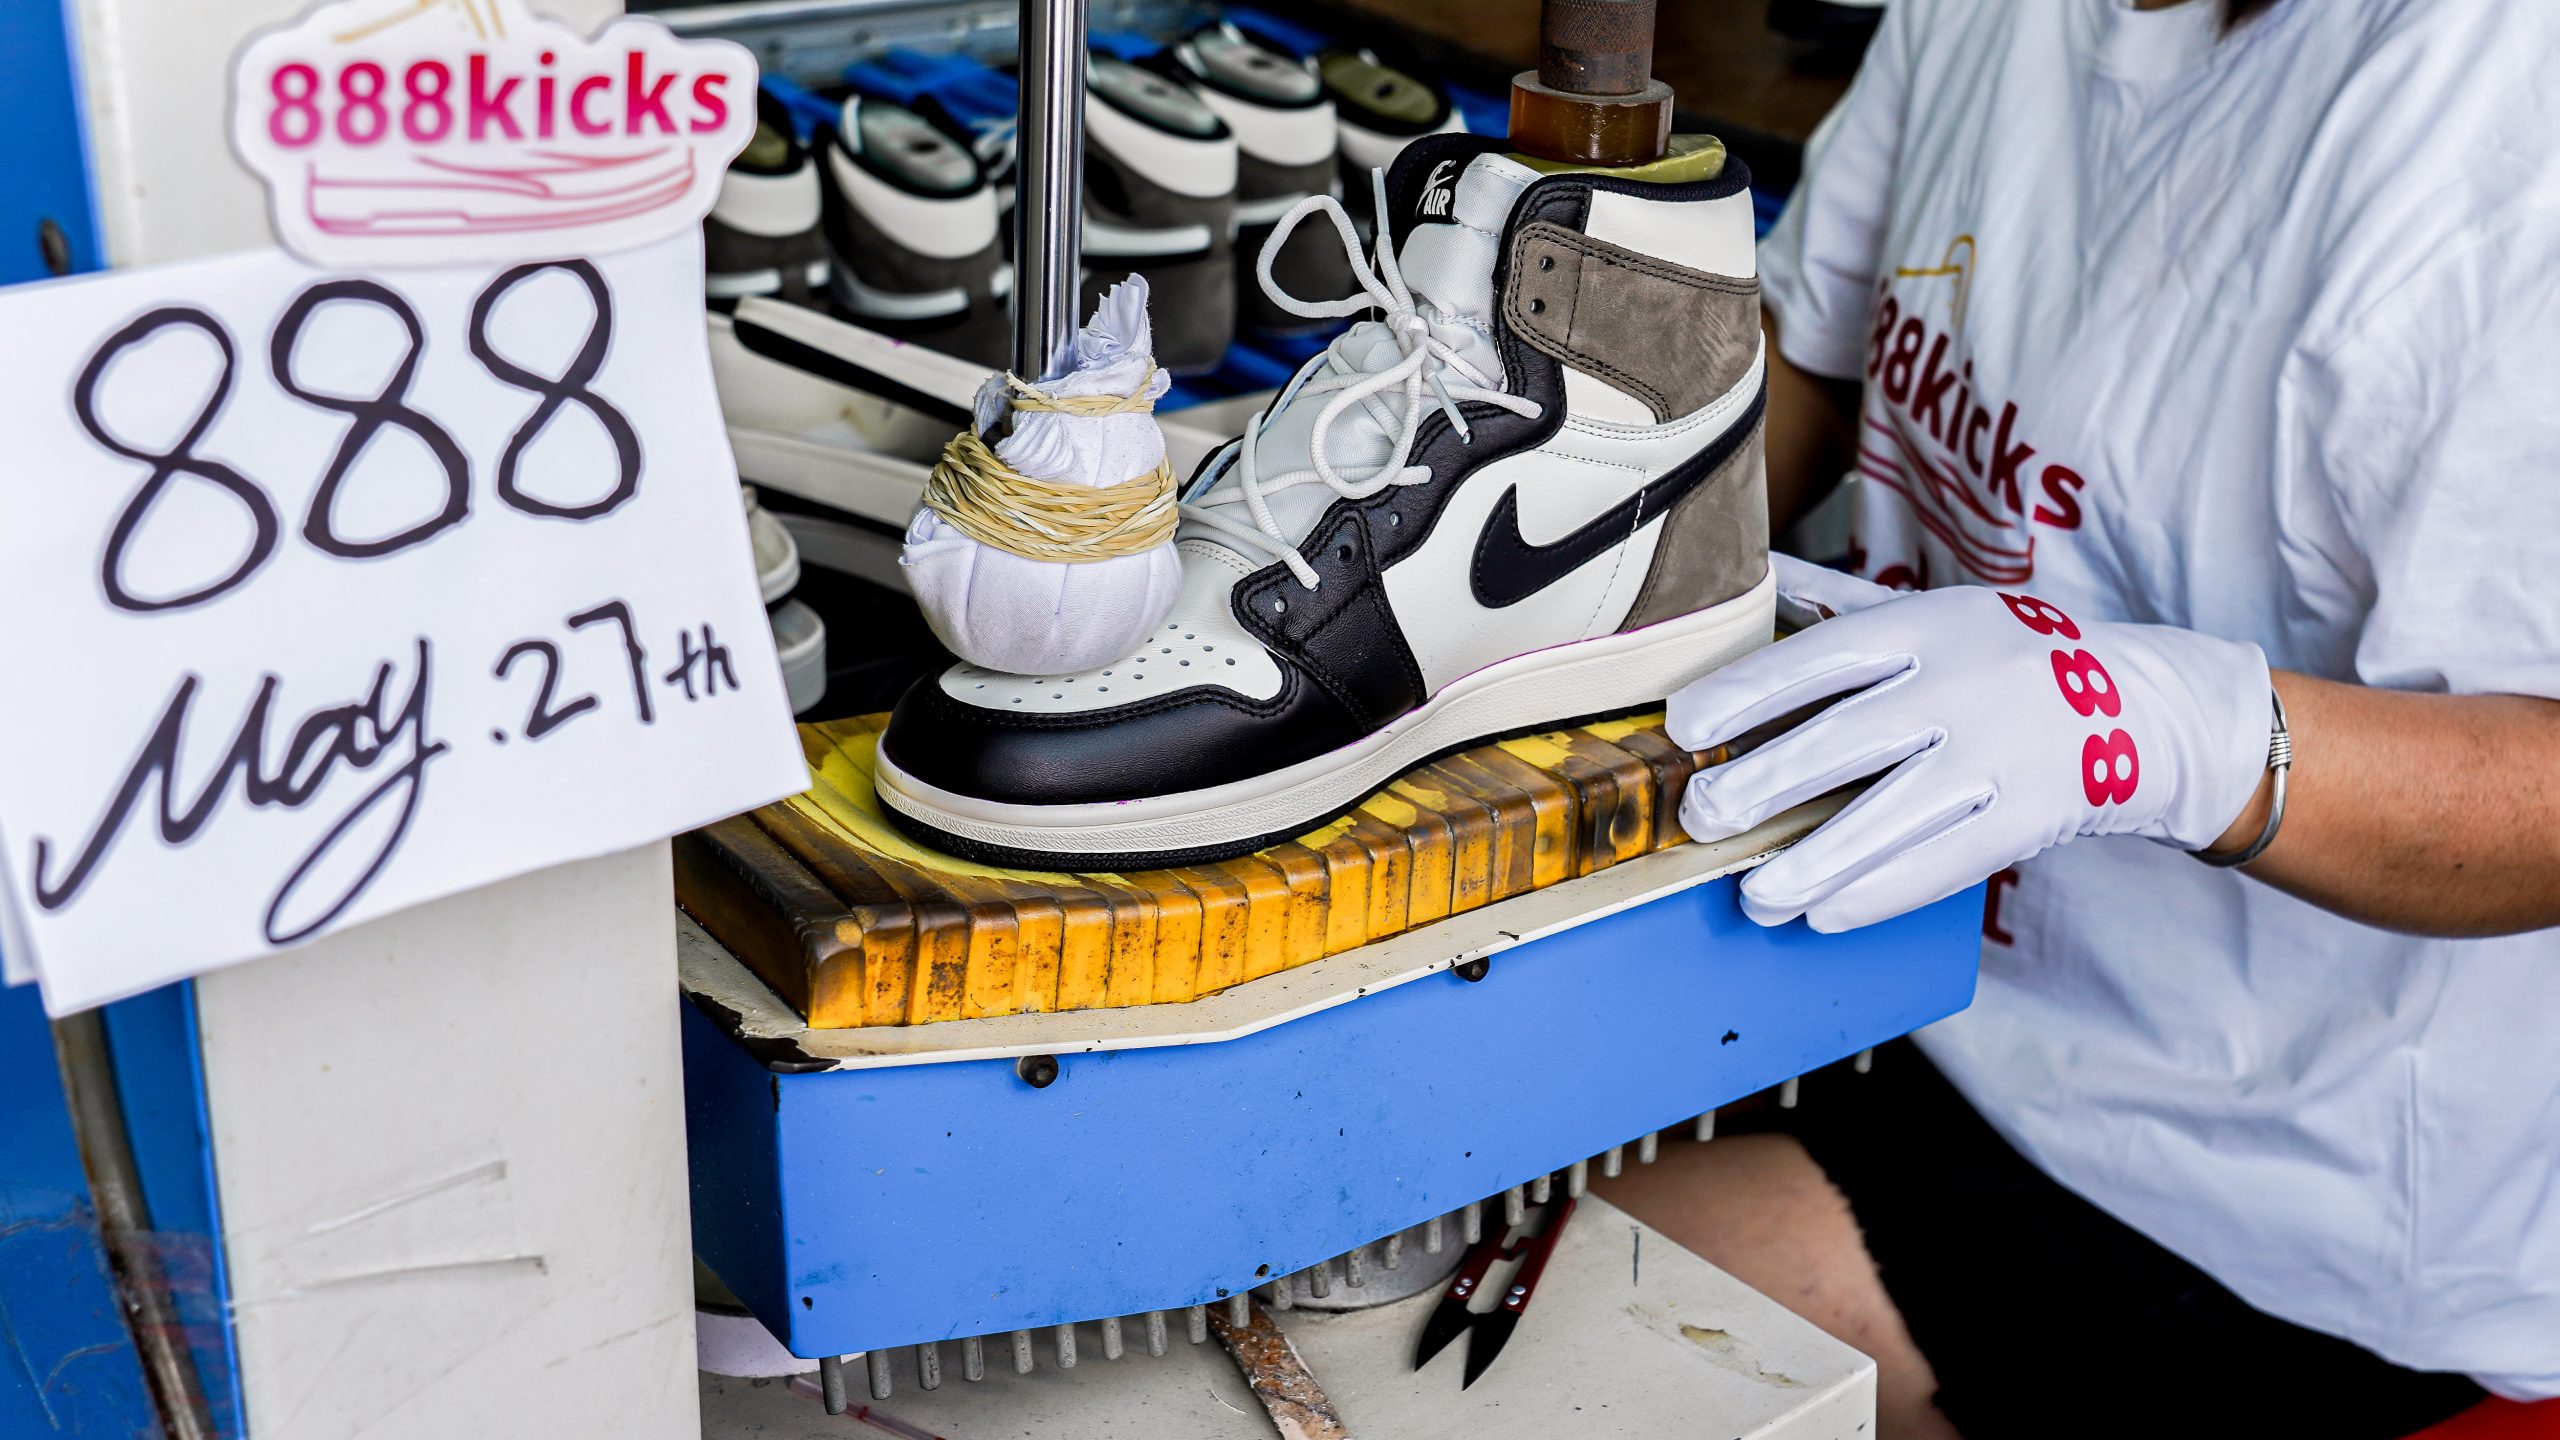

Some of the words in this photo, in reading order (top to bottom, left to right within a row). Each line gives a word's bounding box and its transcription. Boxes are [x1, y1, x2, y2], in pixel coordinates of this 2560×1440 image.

[267, 50, 730, 150] 888kicks
[1423, 188, 1451, 216] AIR
[73, 258, 641, 612] 888
[34, 637, 447, 944] May
[1996, 591, 2140, 808] 888
